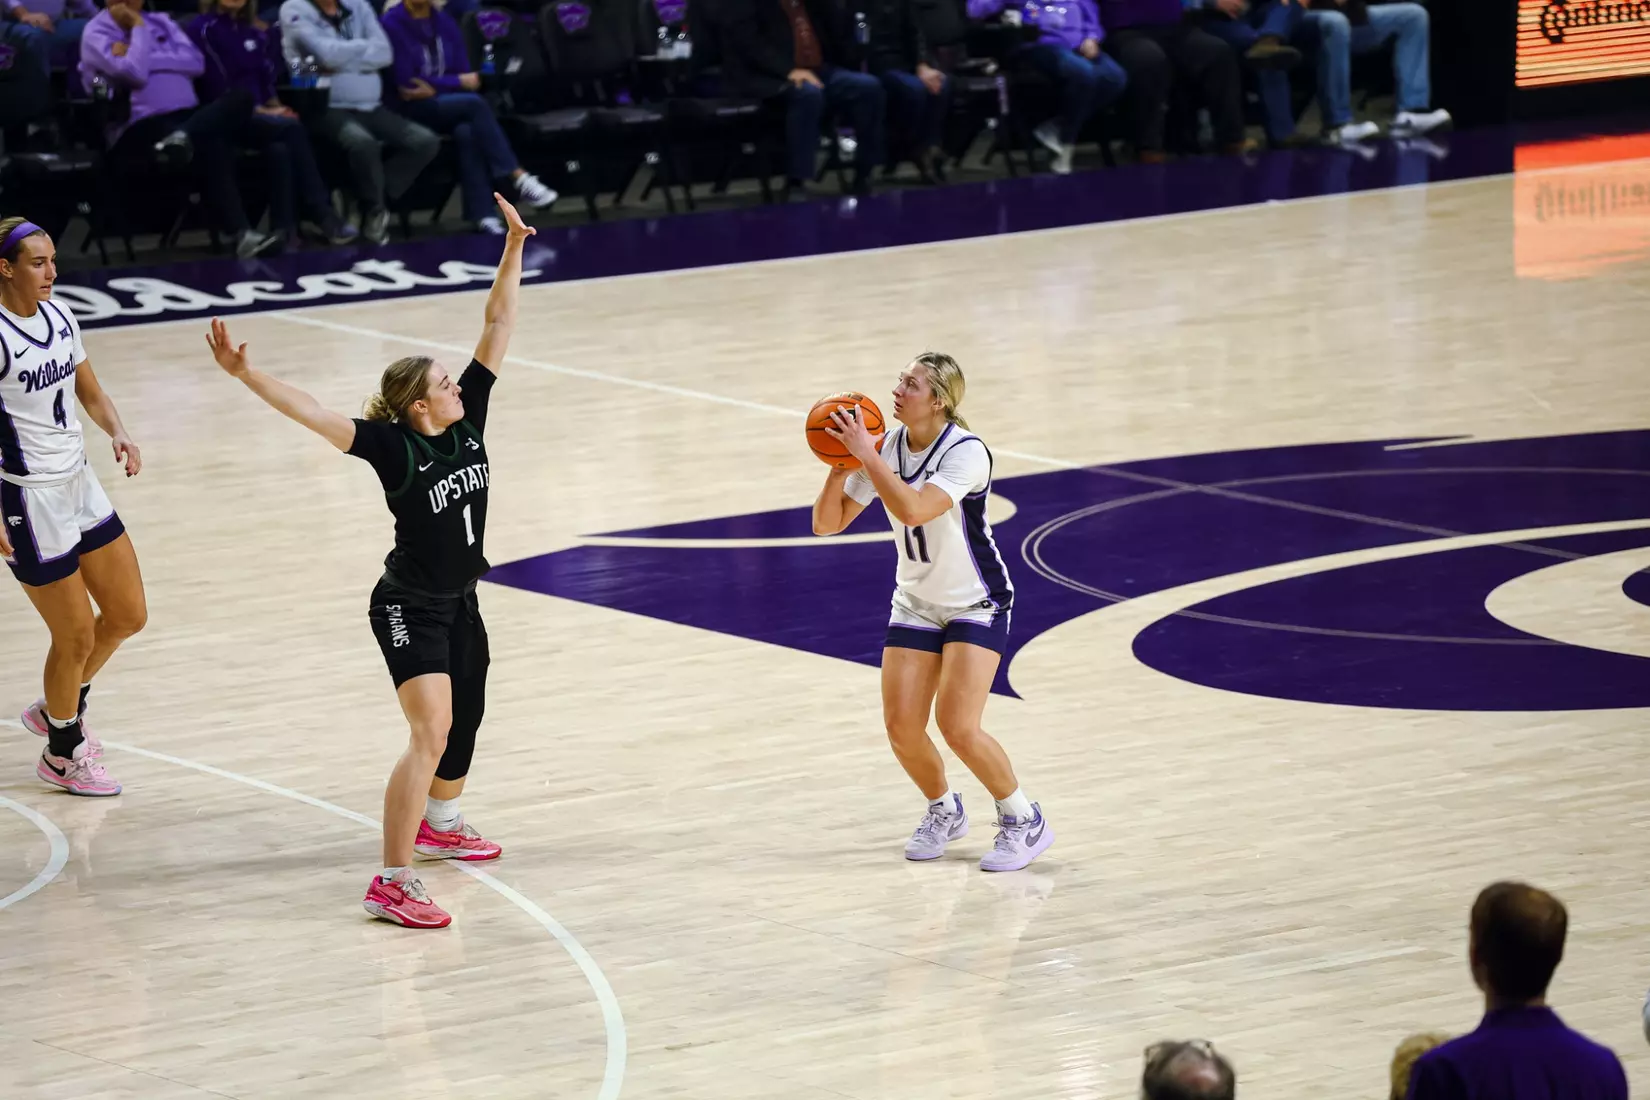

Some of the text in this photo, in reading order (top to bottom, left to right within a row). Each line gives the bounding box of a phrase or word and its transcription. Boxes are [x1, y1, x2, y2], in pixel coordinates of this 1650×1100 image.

[17, 352, 76, 394] Wildcat
[53, 387, 68, 430] 4
[462, 503, 476, 547] 1
[904, 525, 932, 564] 11
